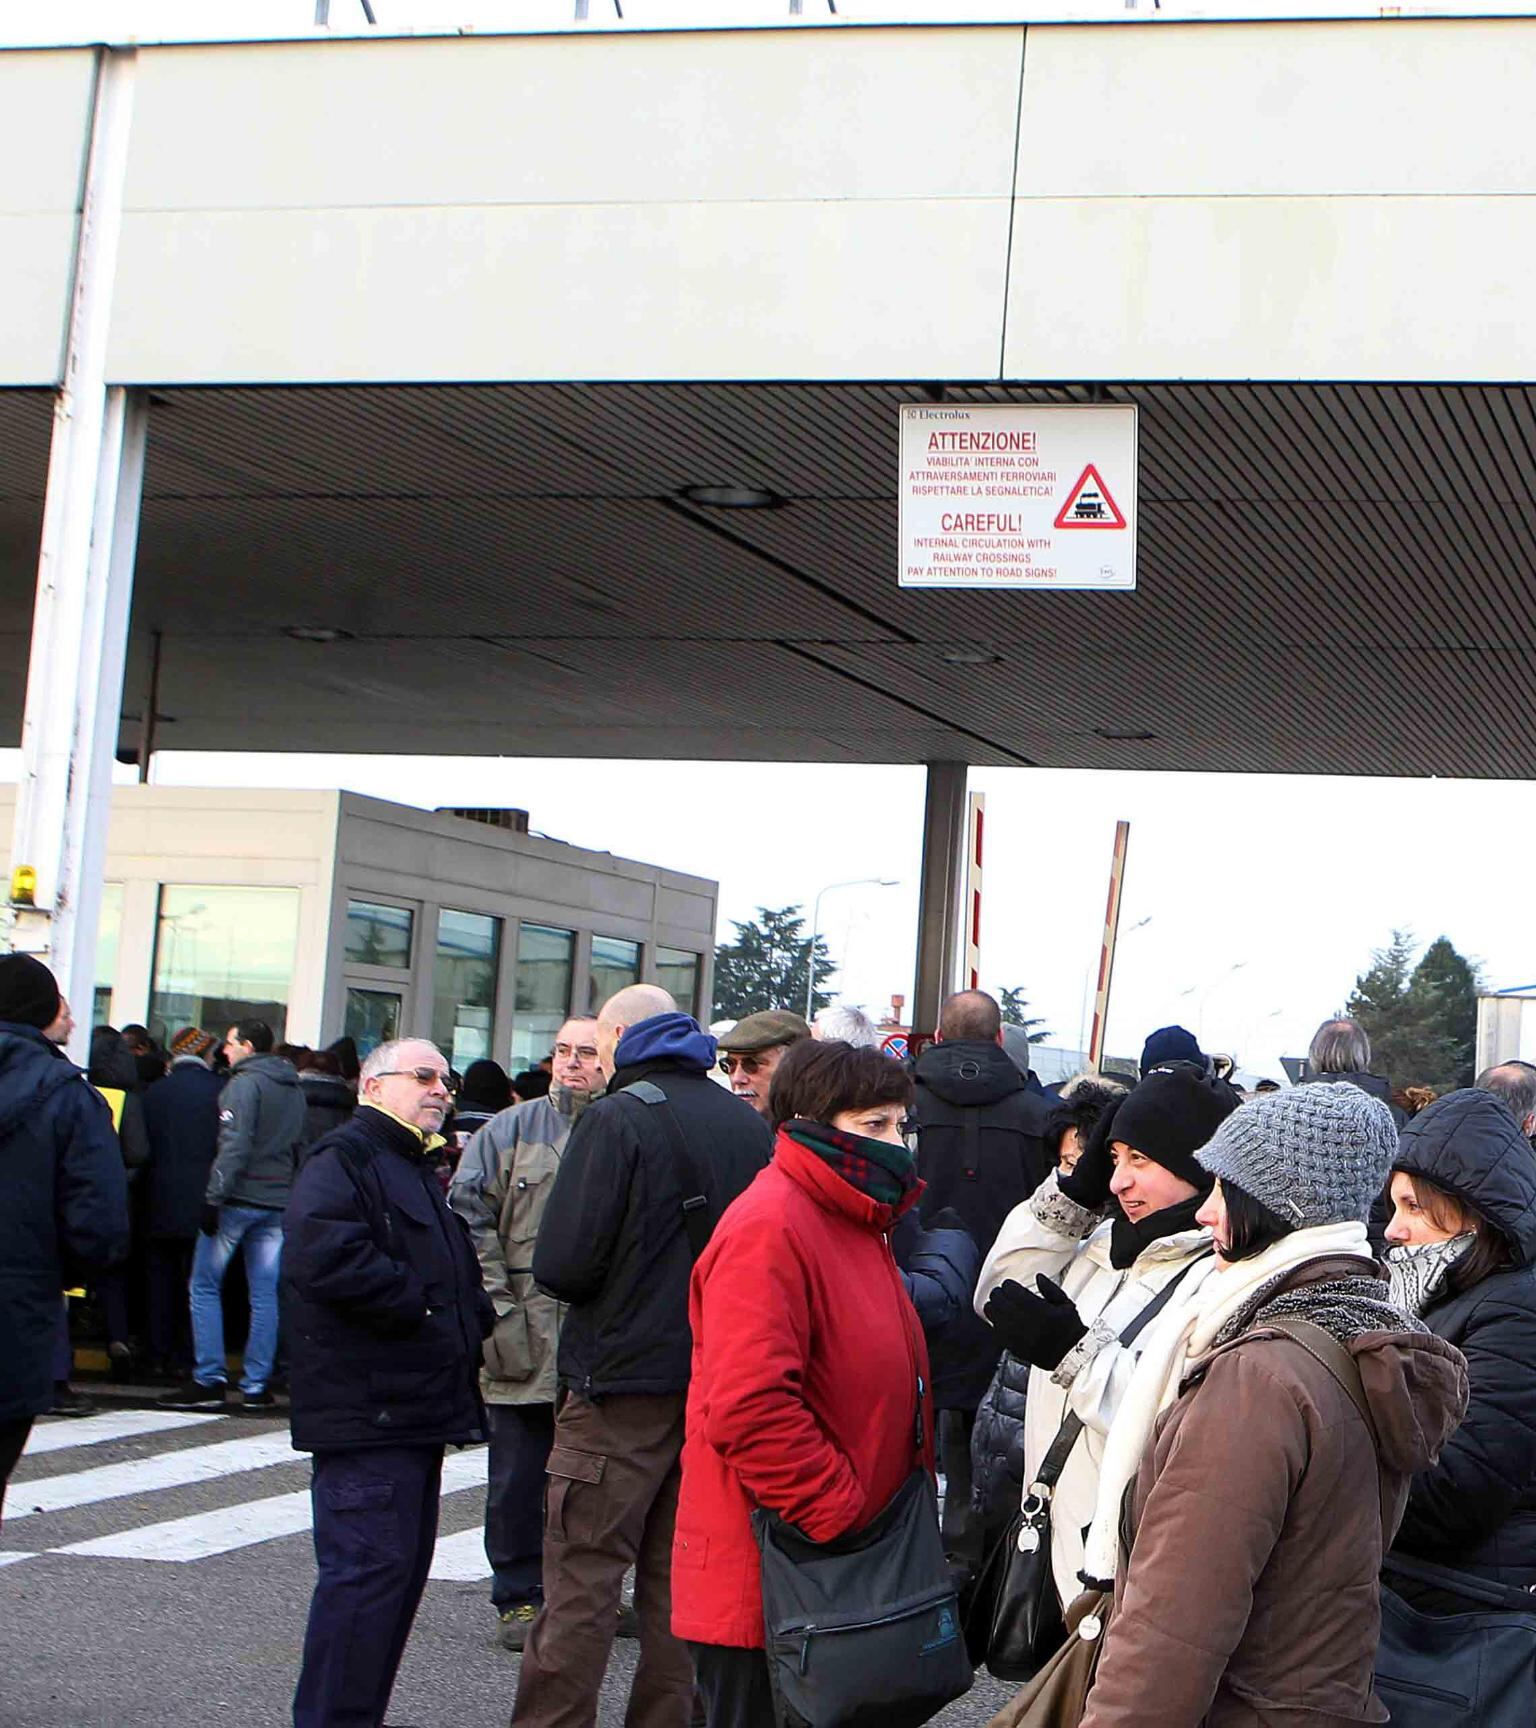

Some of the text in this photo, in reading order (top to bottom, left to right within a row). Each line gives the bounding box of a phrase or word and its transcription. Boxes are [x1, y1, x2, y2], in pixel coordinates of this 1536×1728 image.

[919, 411, 971, 420] Electrolux
[928, 432, 1036, 450] ATTENZIONE!
[927, 457, 1039, 467] VIABILITA' INTERNA CON
[909, 471, 1057, 482] ATTRAVERSAMENTI FERROVIARI
[912, 486, 1053, 496] RISPETTARE LA SEGNALETICA!
[941, 513, 1022, 532] CAREFUL!
[914, 538, 1051, 549] INTERNAL CIRCULATION WITH
[933, 552, 1032, 563] RAILWAY CROSSINGS
[907, 566, 1057, 578] PAY ATTENTION TO ROAD SIGNS!
